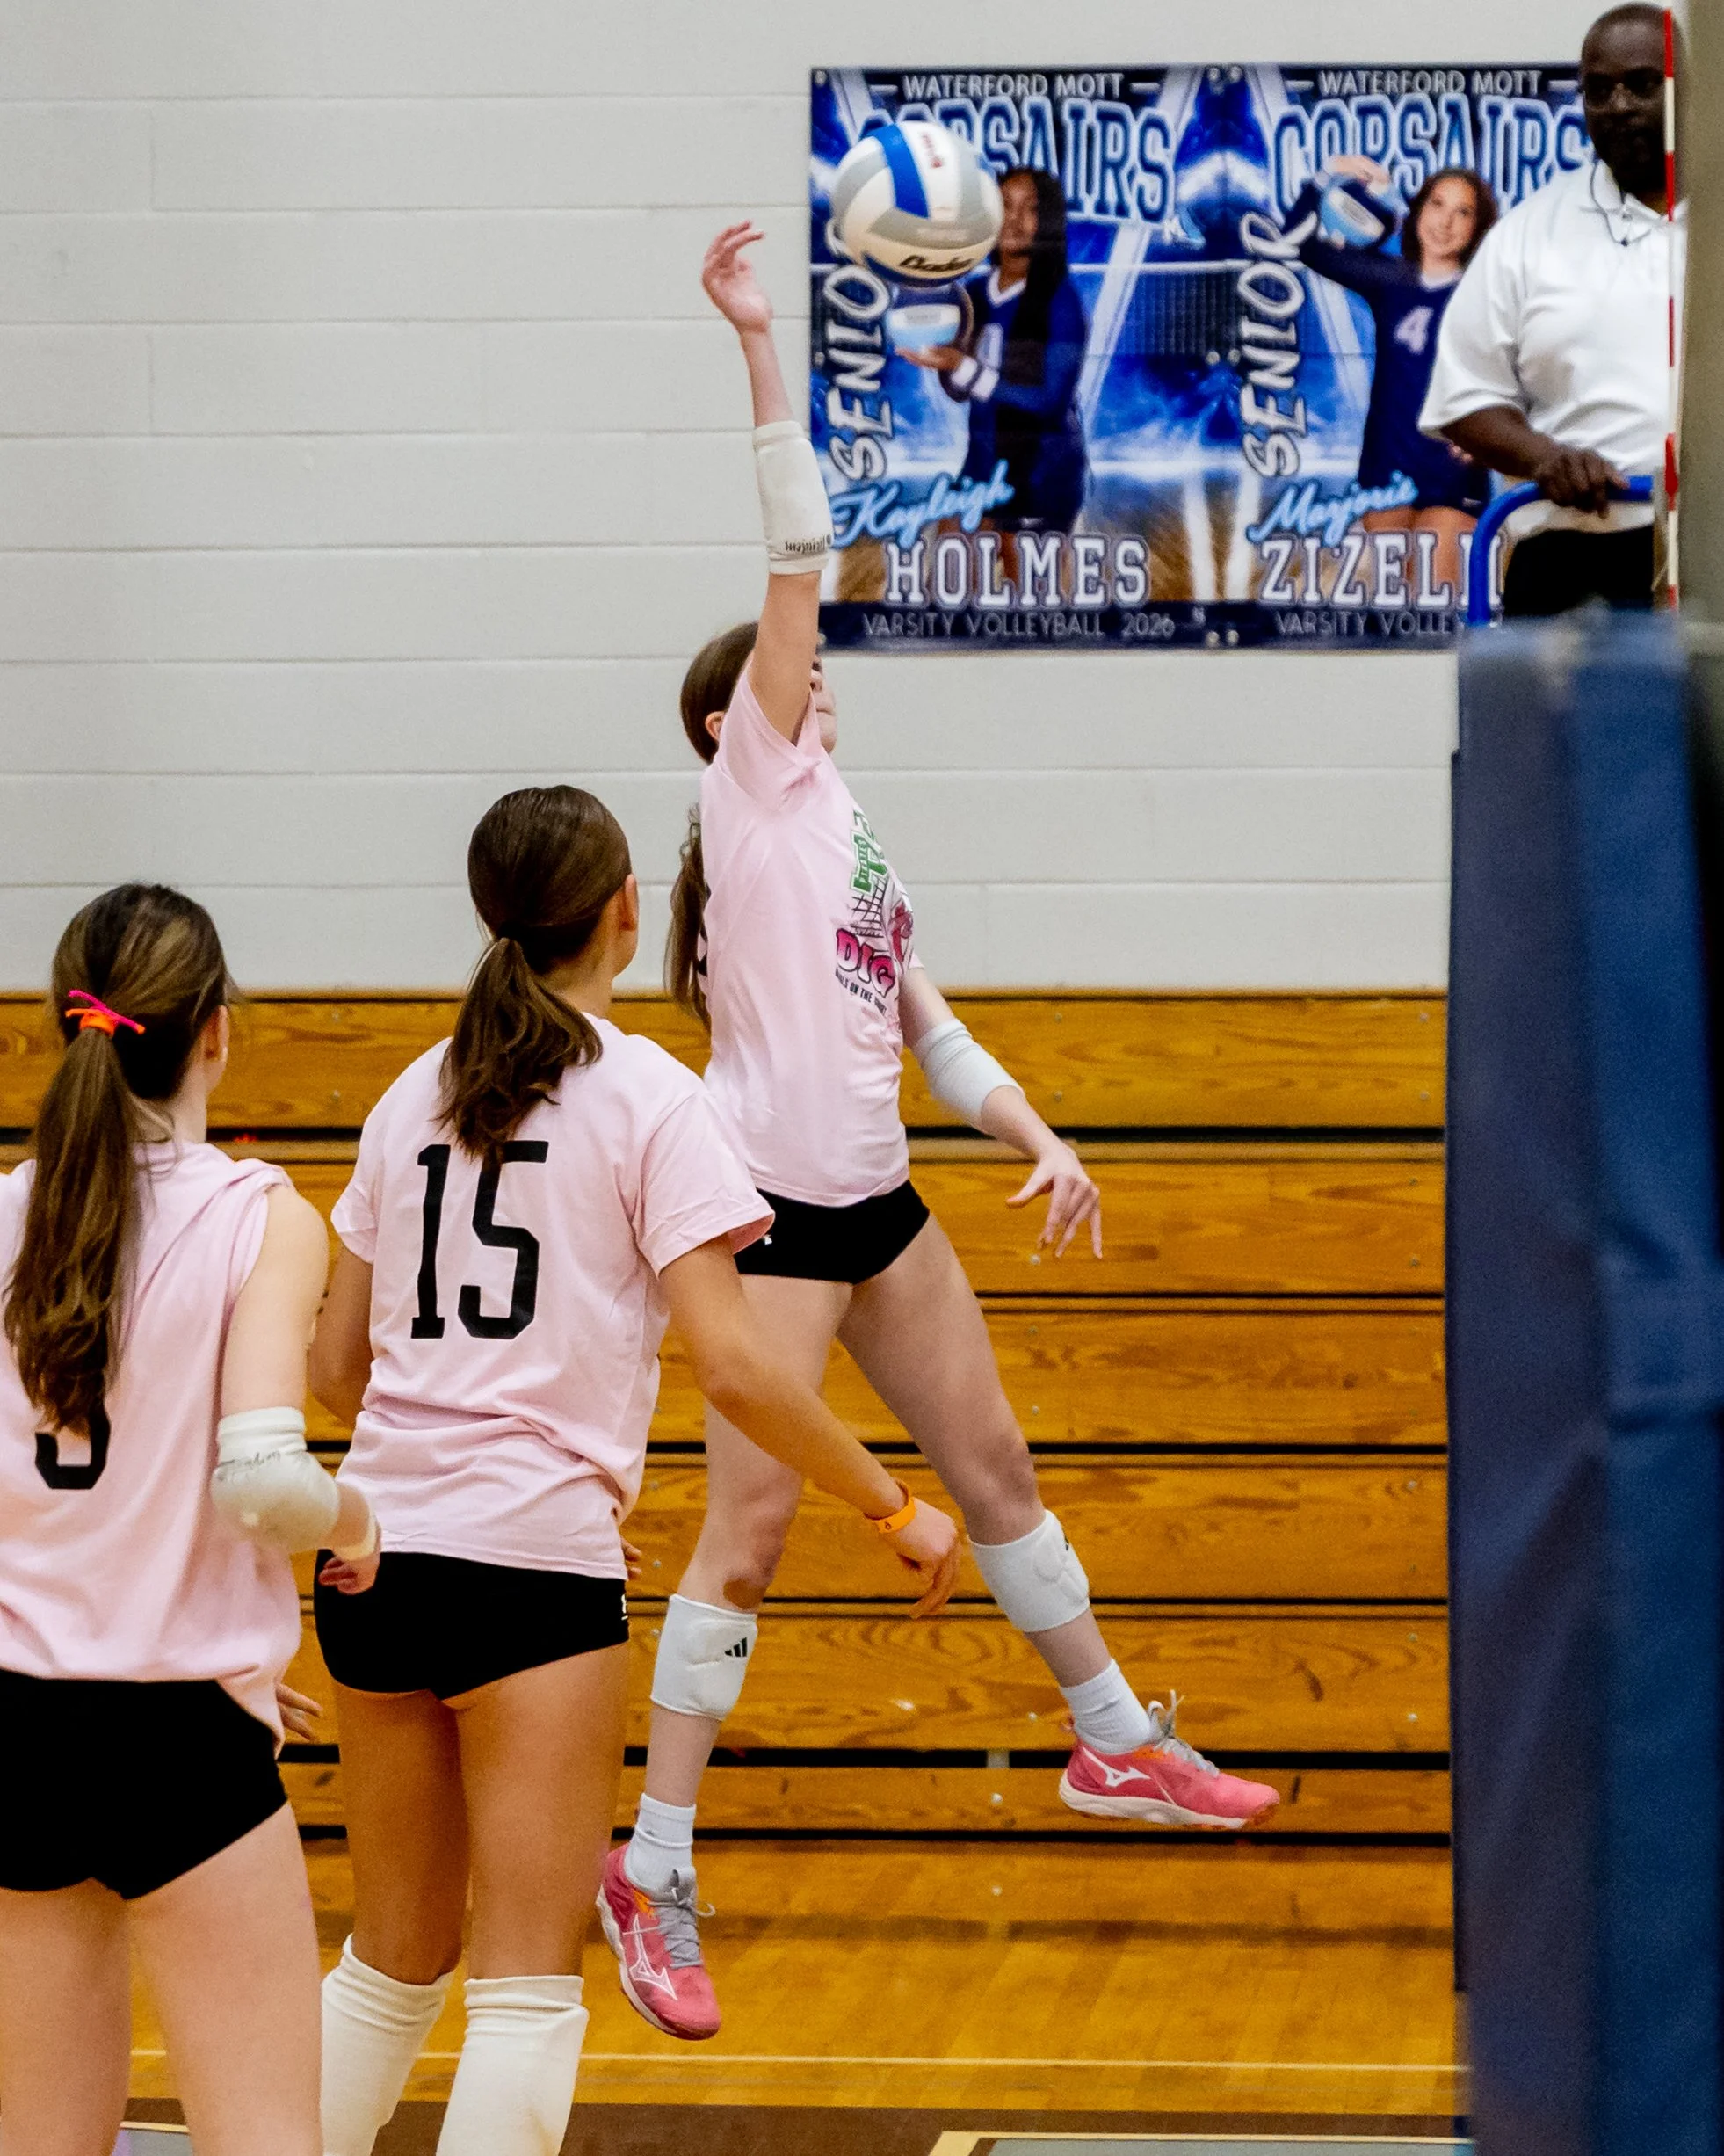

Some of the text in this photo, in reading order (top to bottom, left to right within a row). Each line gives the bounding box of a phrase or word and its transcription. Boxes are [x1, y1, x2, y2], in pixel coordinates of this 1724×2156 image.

[903, 73, 1125, 99] WATERFORD MOTT
[1320, 69, 1542, 96] WATERFORD MOTT
[1237, 211, 1317, 477] SENIOR
[1394, 306, 1434, 353] 4
[831, 461, 1014, 548] Kayleigh
[885, 532, 1149, 609] HOLMES
[863, 613, 955, 637] VARSITY
[967, 613, 1105, 639] VOLLEYBALL
[1275, 612, 1465, 635] VARSITY VOLLE
[836, 927, 895, 998] DIG
[411, 1140, 549, 1340] 15
